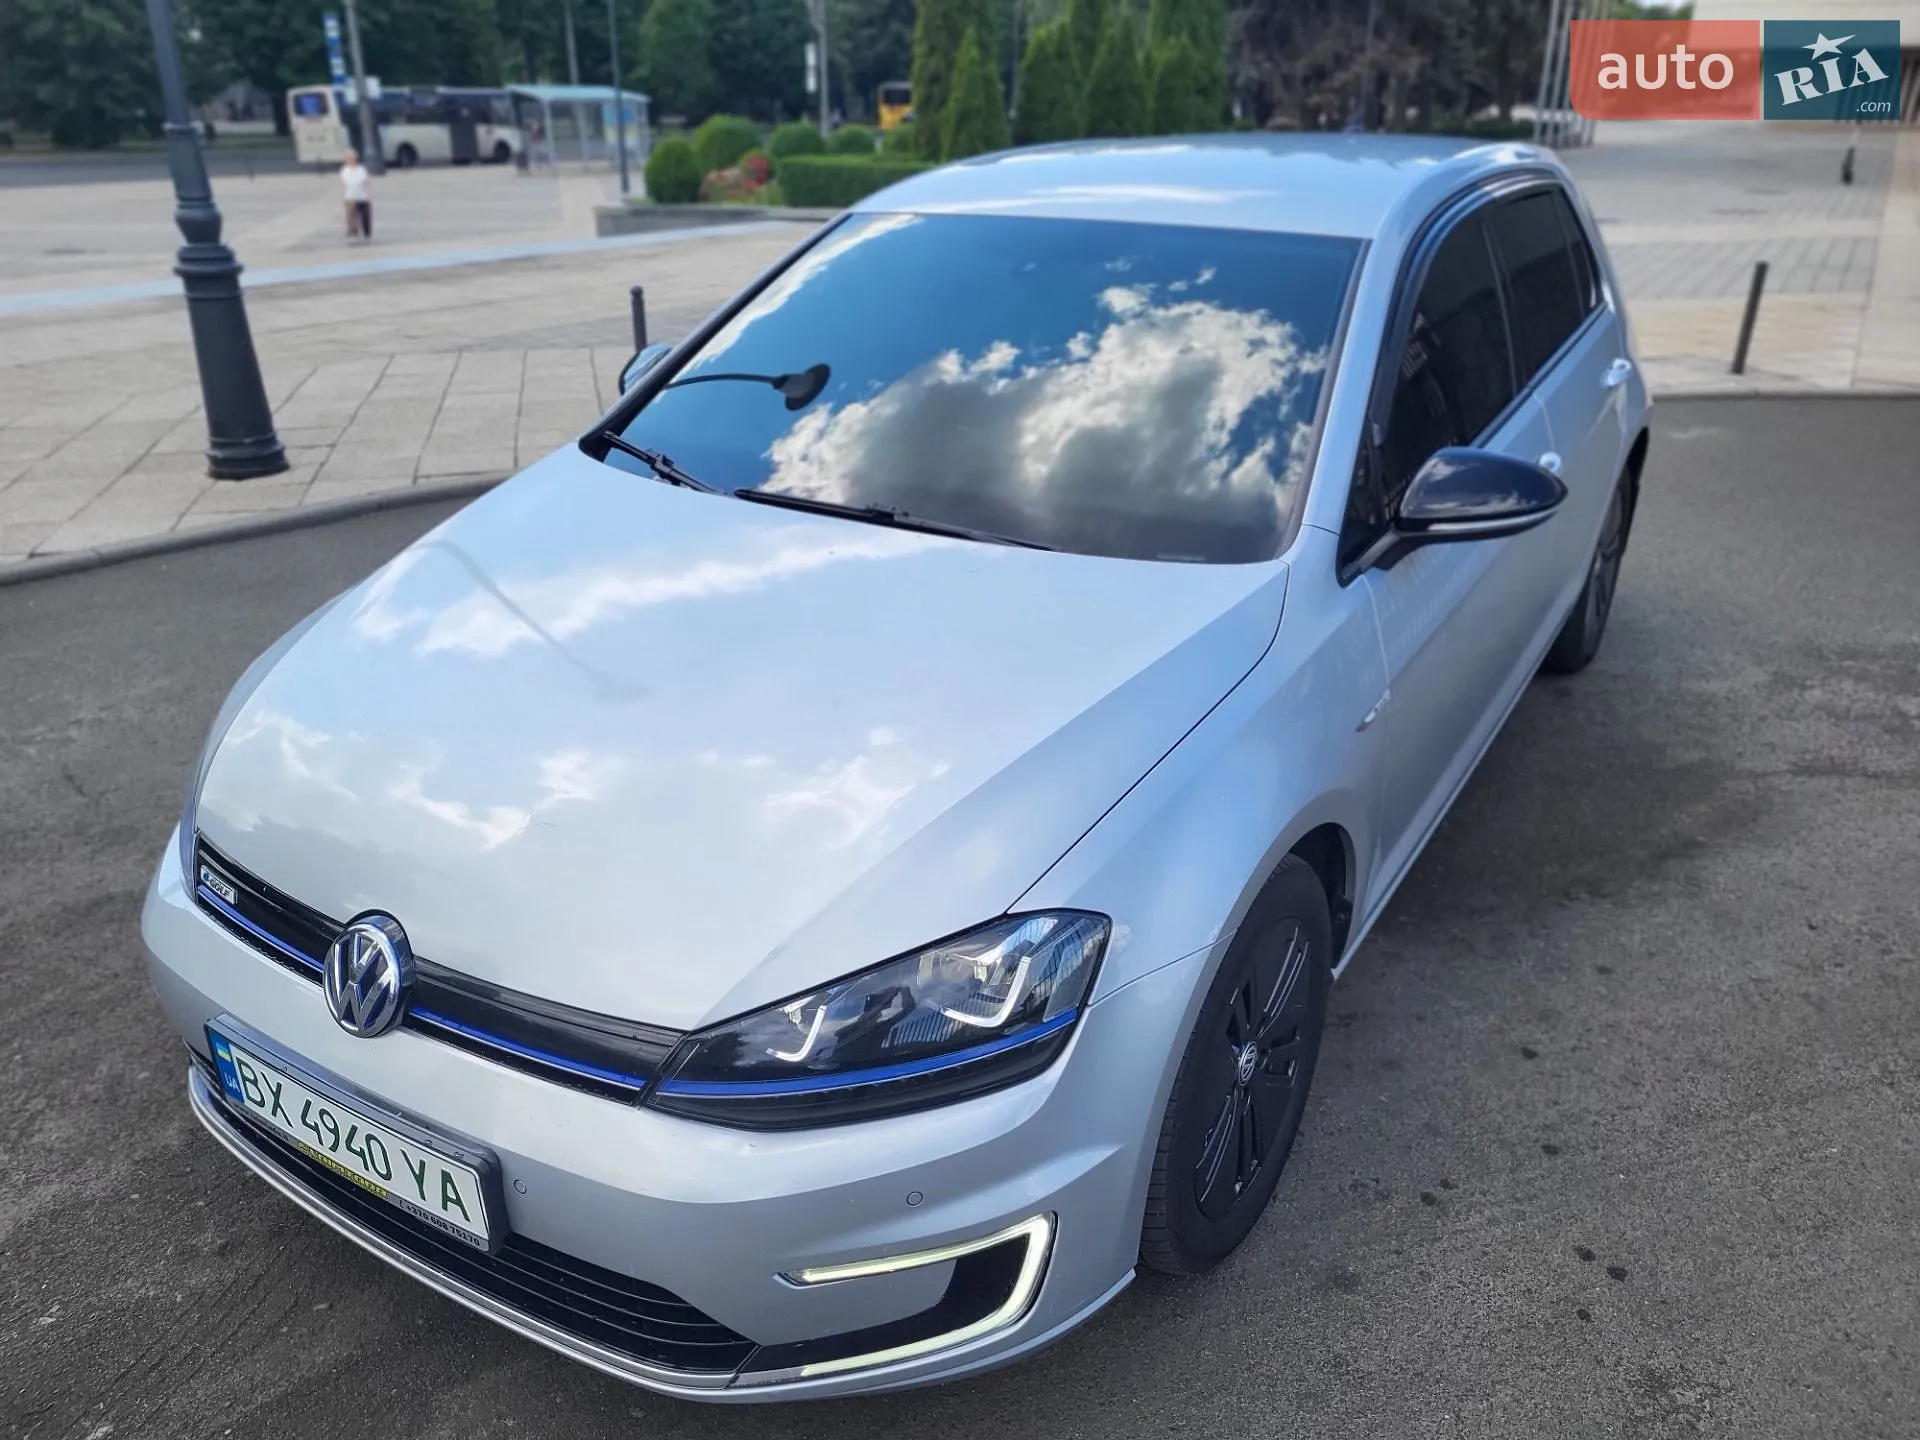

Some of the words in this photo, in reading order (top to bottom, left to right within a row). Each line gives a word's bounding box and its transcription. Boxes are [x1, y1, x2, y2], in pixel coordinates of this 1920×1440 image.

[235, 1056, 293, 1128] BX
[300, 1099, 392, 1181] 4940
[400, 1149, 471, 1223] YA
